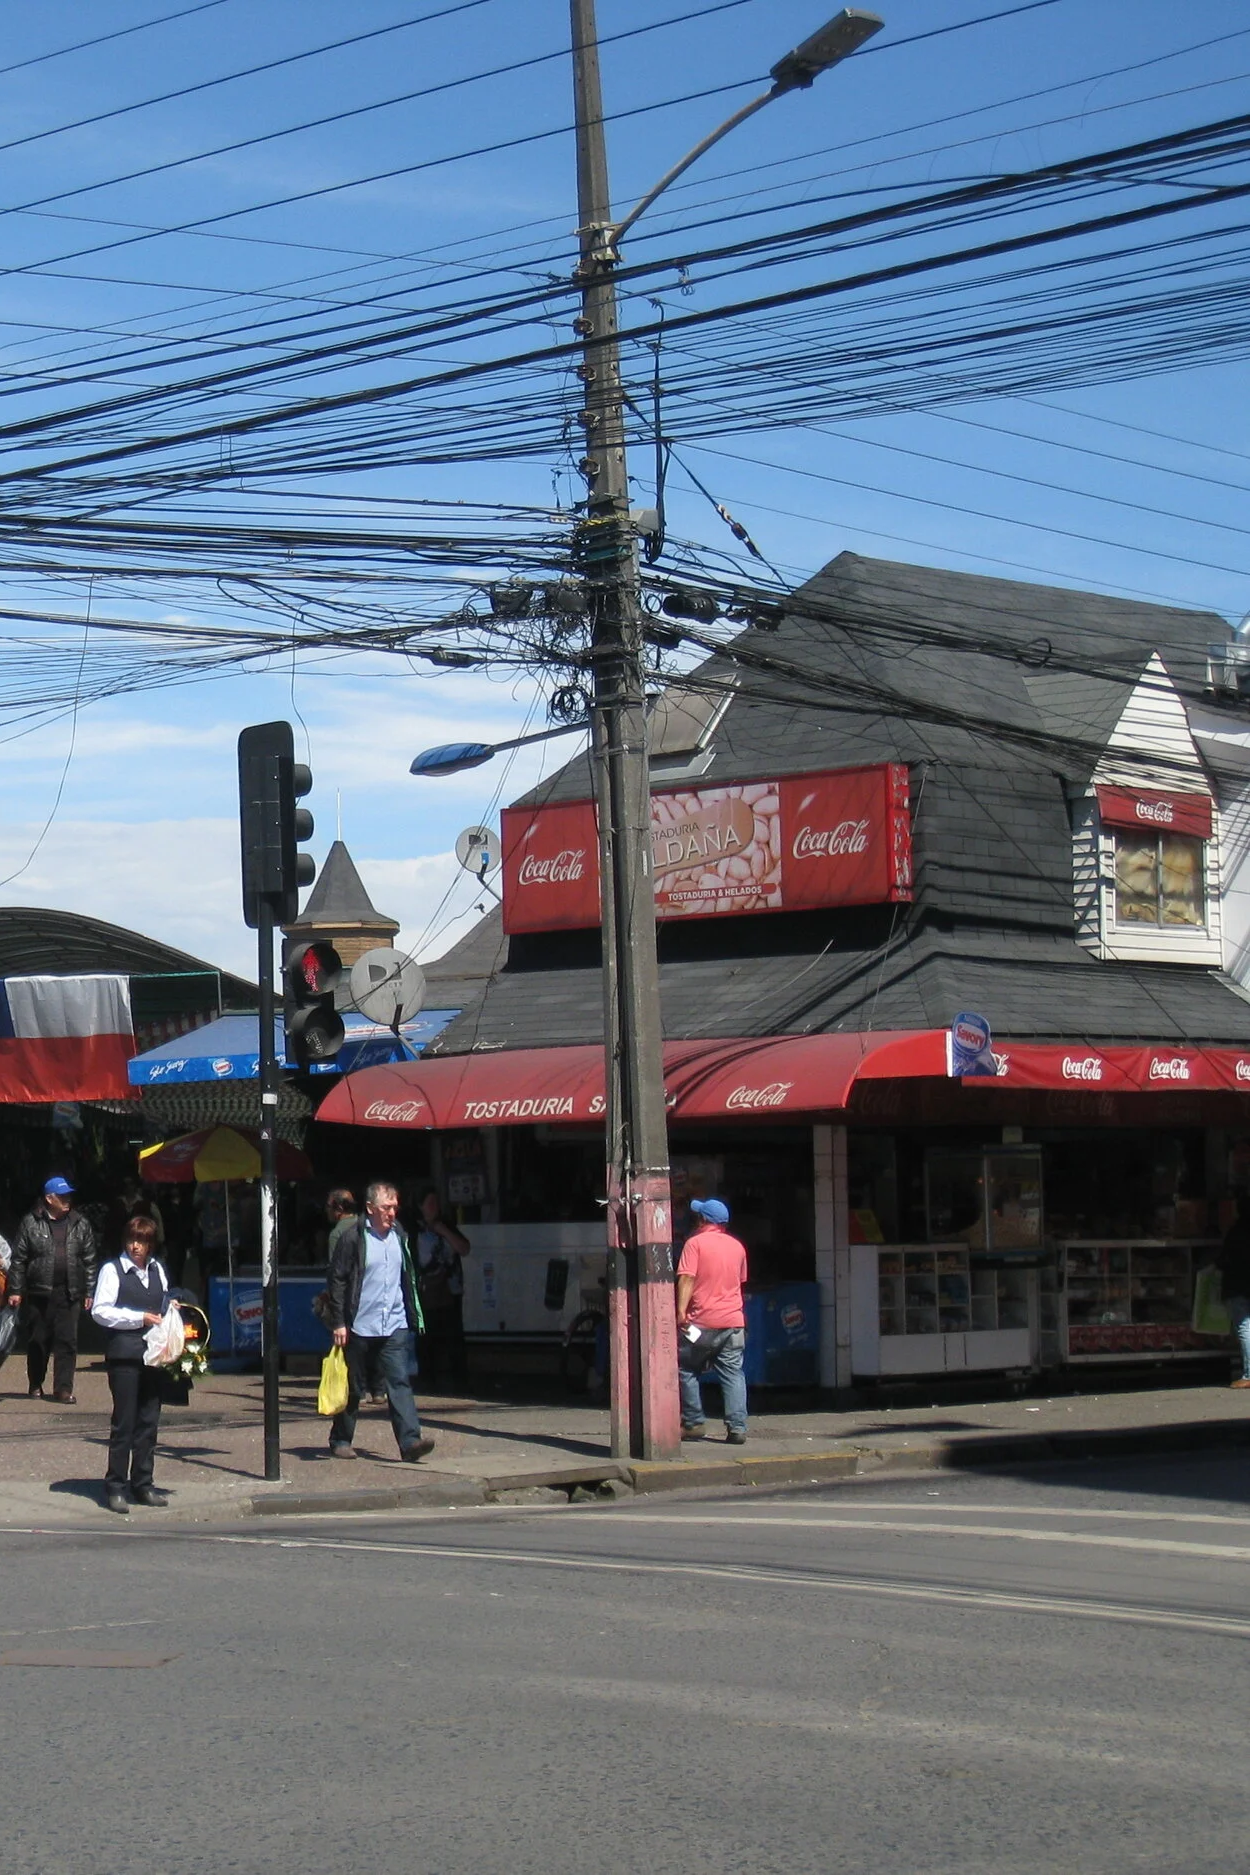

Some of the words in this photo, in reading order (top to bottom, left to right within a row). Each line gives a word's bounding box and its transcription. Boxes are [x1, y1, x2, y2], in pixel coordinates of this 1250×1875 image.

[652, 824, 743, 869] LDAÑA
[792, 820, 871, 861] Coca-Cola
[518, 850, 586, 887] Coca-Cola
[667, 887, 717, 902] TOSTADURIA
[717, 888, 724, 898] &
[724, 885, 763, 898] HELADOS
[1062, 1056, 1102, 1081] Coca-Cola
[1149, 1057, 1190, 1080] Coca-Cola
[725, 1081, 795, 1110] Coca-Cola
[364, 1099, 428, 1122] Coca-Cola
[463, 1096, 573, 1120] TOSTADURIA
[236, 1306, 264, 1322] Savo
